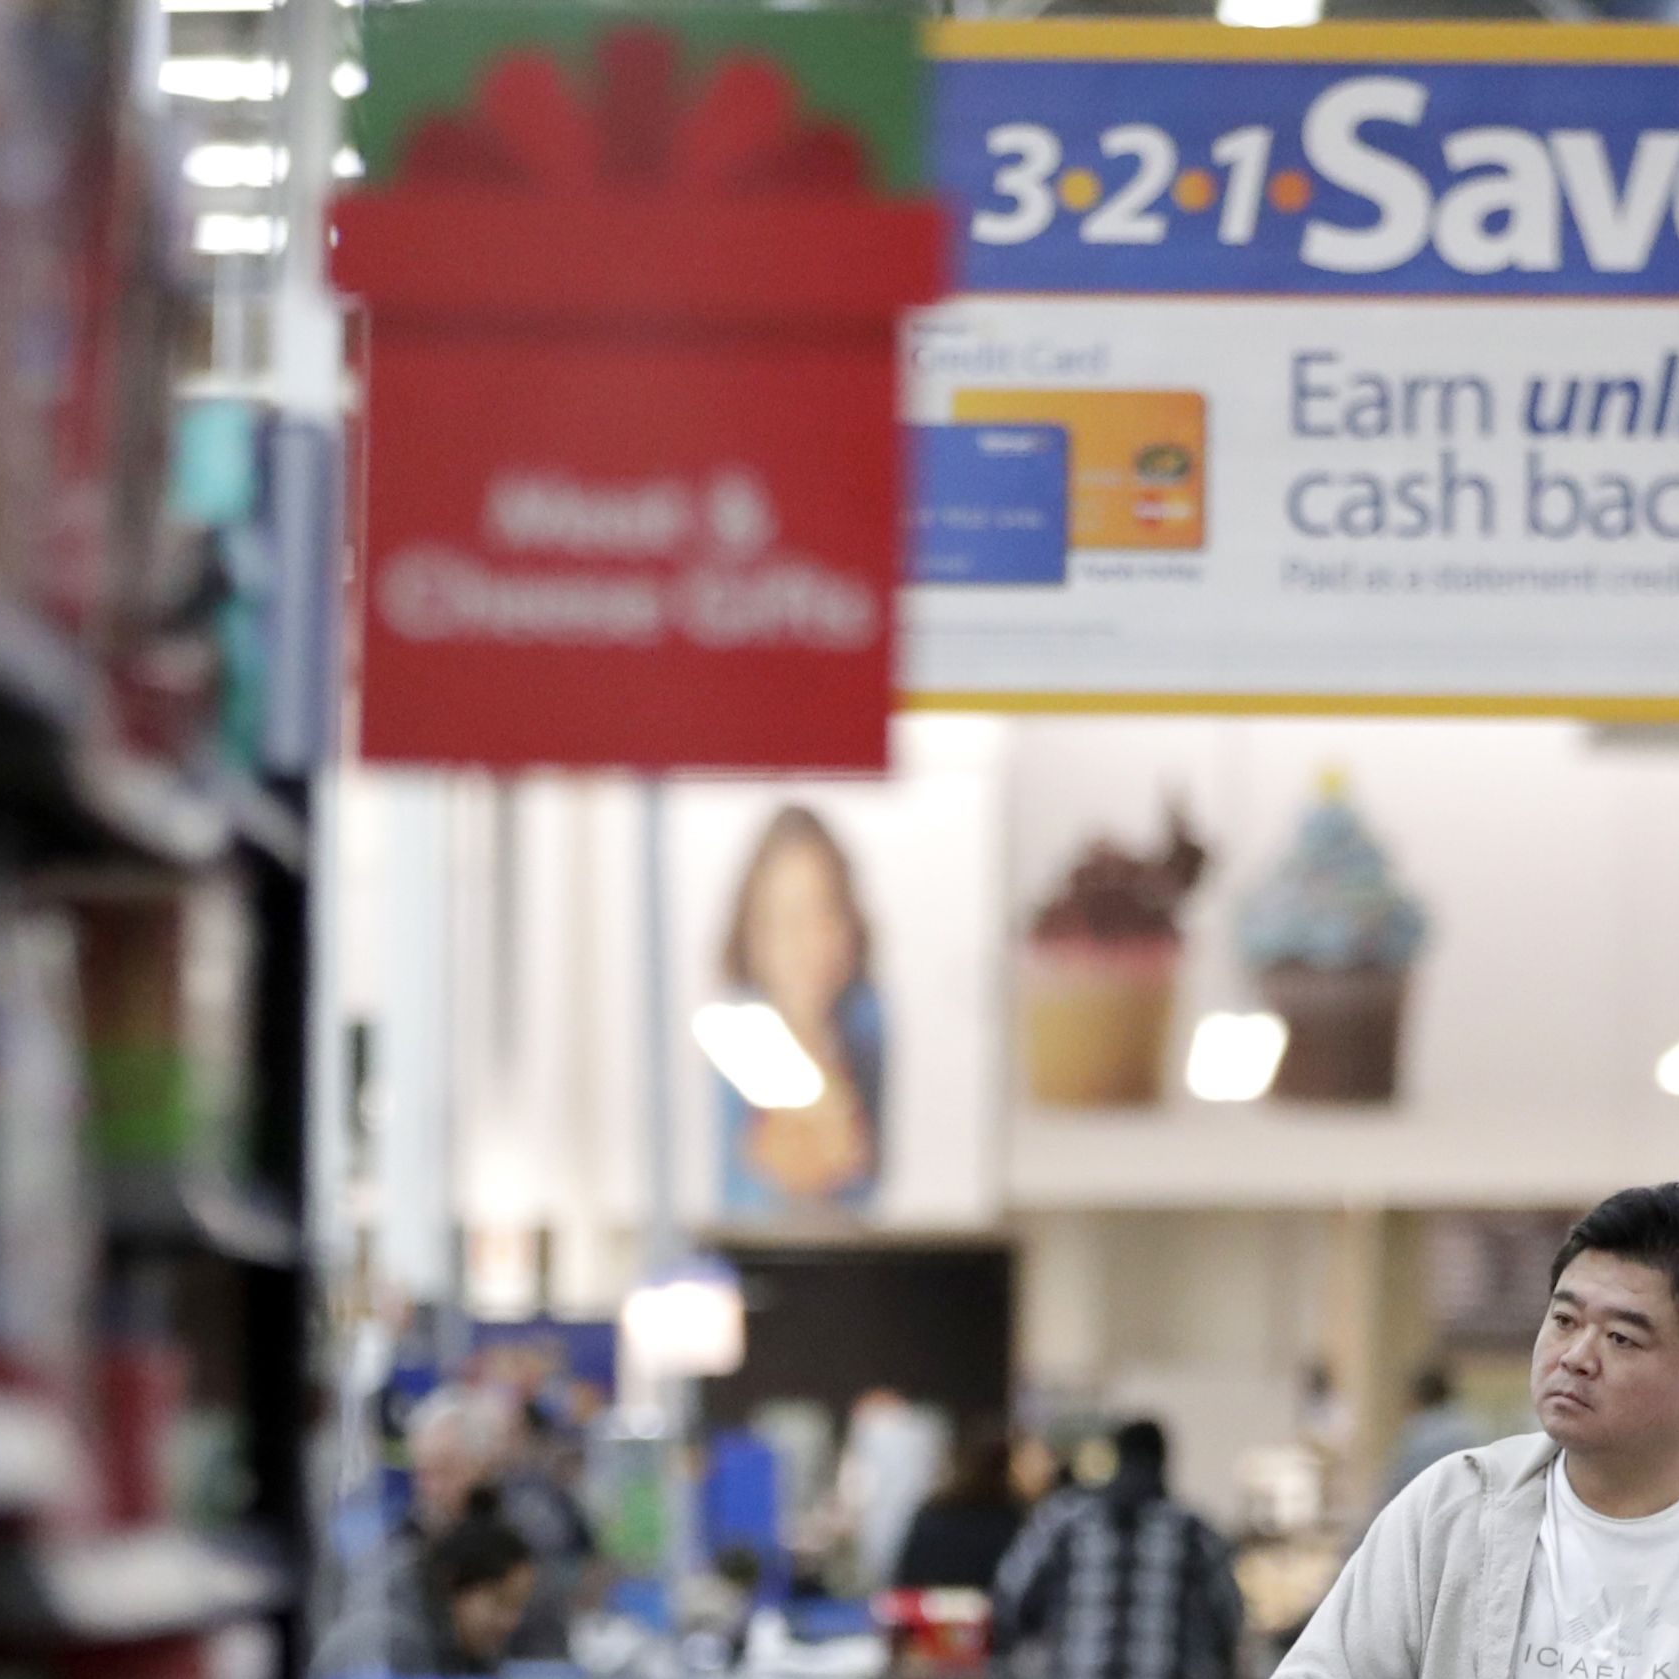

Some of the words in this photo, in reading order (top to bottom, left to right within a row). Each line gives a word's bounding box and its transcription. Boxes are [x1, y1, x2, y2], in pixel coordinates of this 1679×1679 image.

[1289, 350, 1496, 441] Earn
[1284, 451, 1498, 541] cash
[1281, 557, 1355, 594] Paid
[1433, 558, 1598, 595] statement
